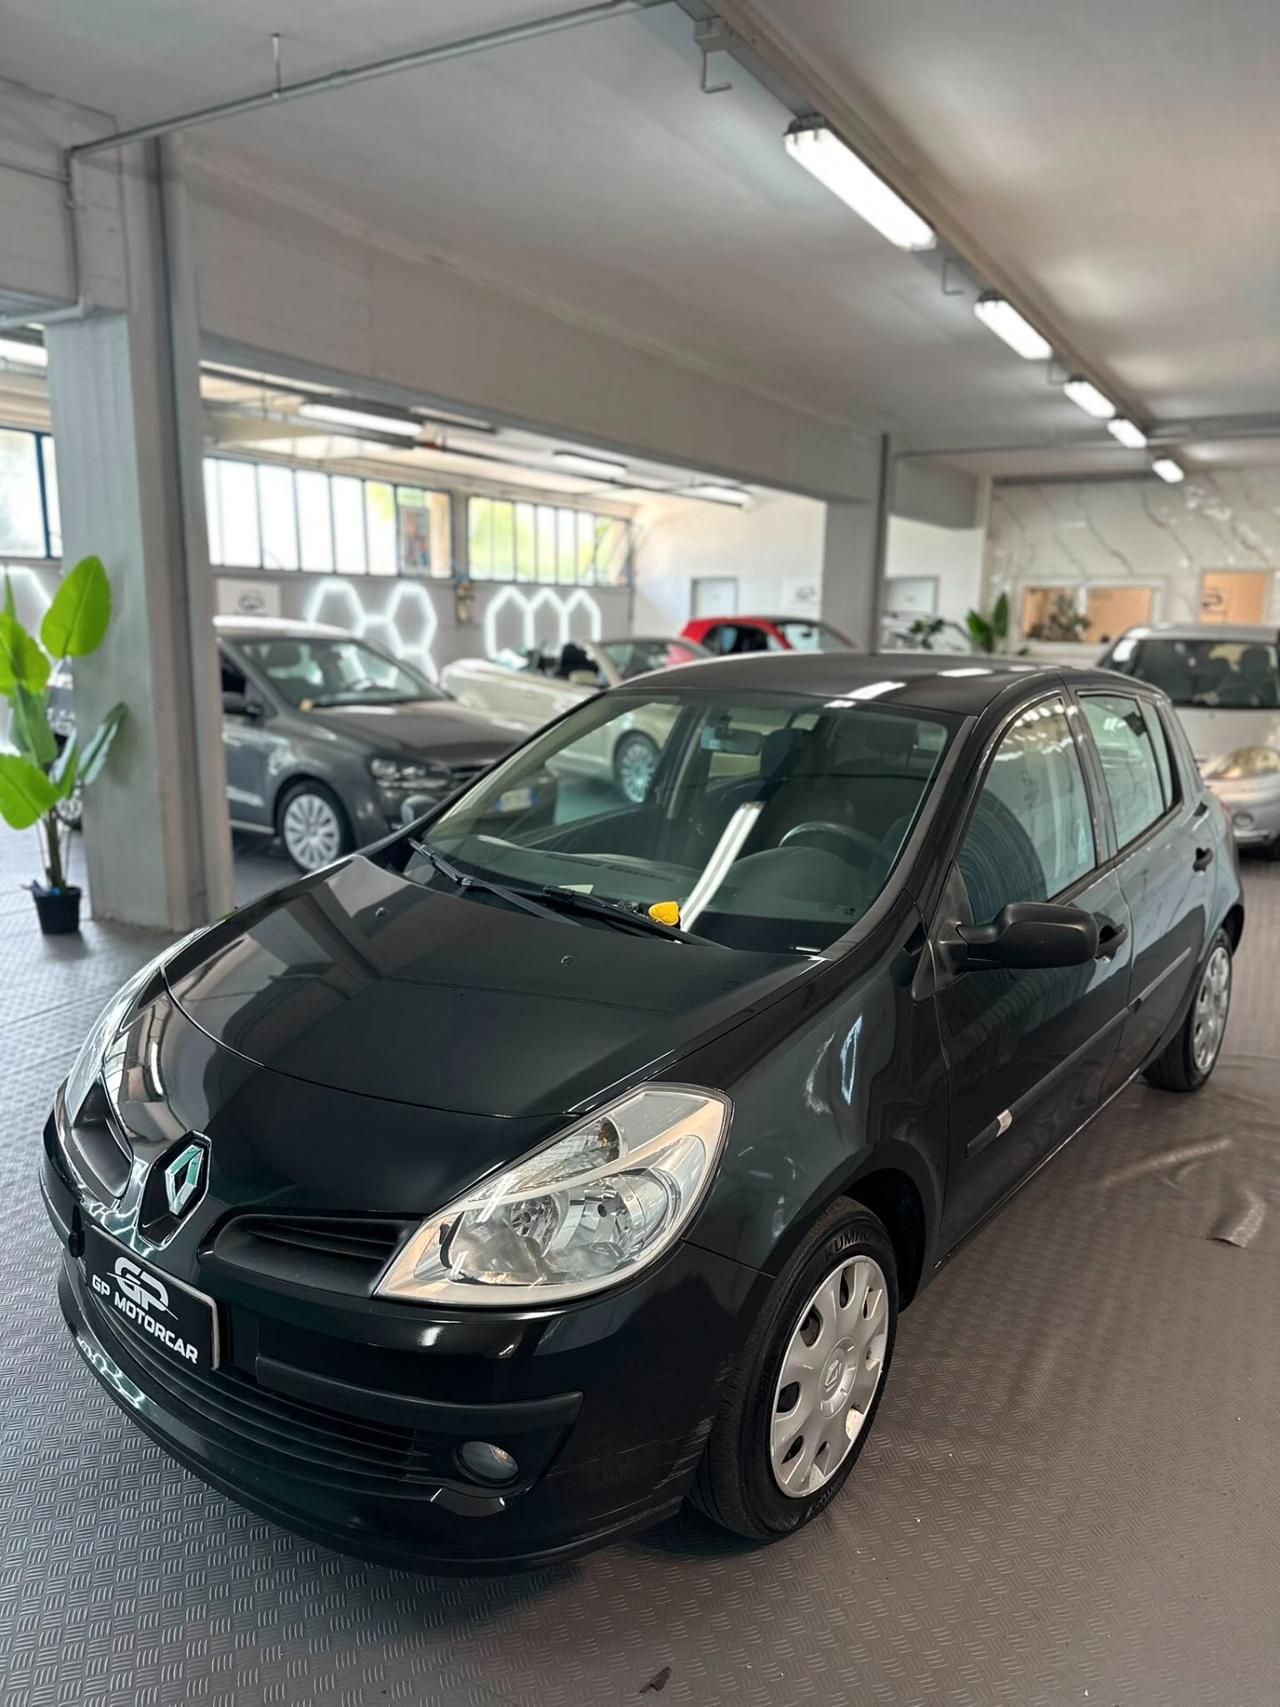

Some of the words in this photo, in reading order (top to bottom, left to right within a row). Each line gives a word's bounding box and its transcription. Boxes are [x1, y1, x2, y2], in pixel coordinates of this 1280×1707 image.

[91, 1273, 111, 1297] GP
[114, 1291, 199, 1365] MOTORCAR
[111, 1256, 172, 1315] GP
